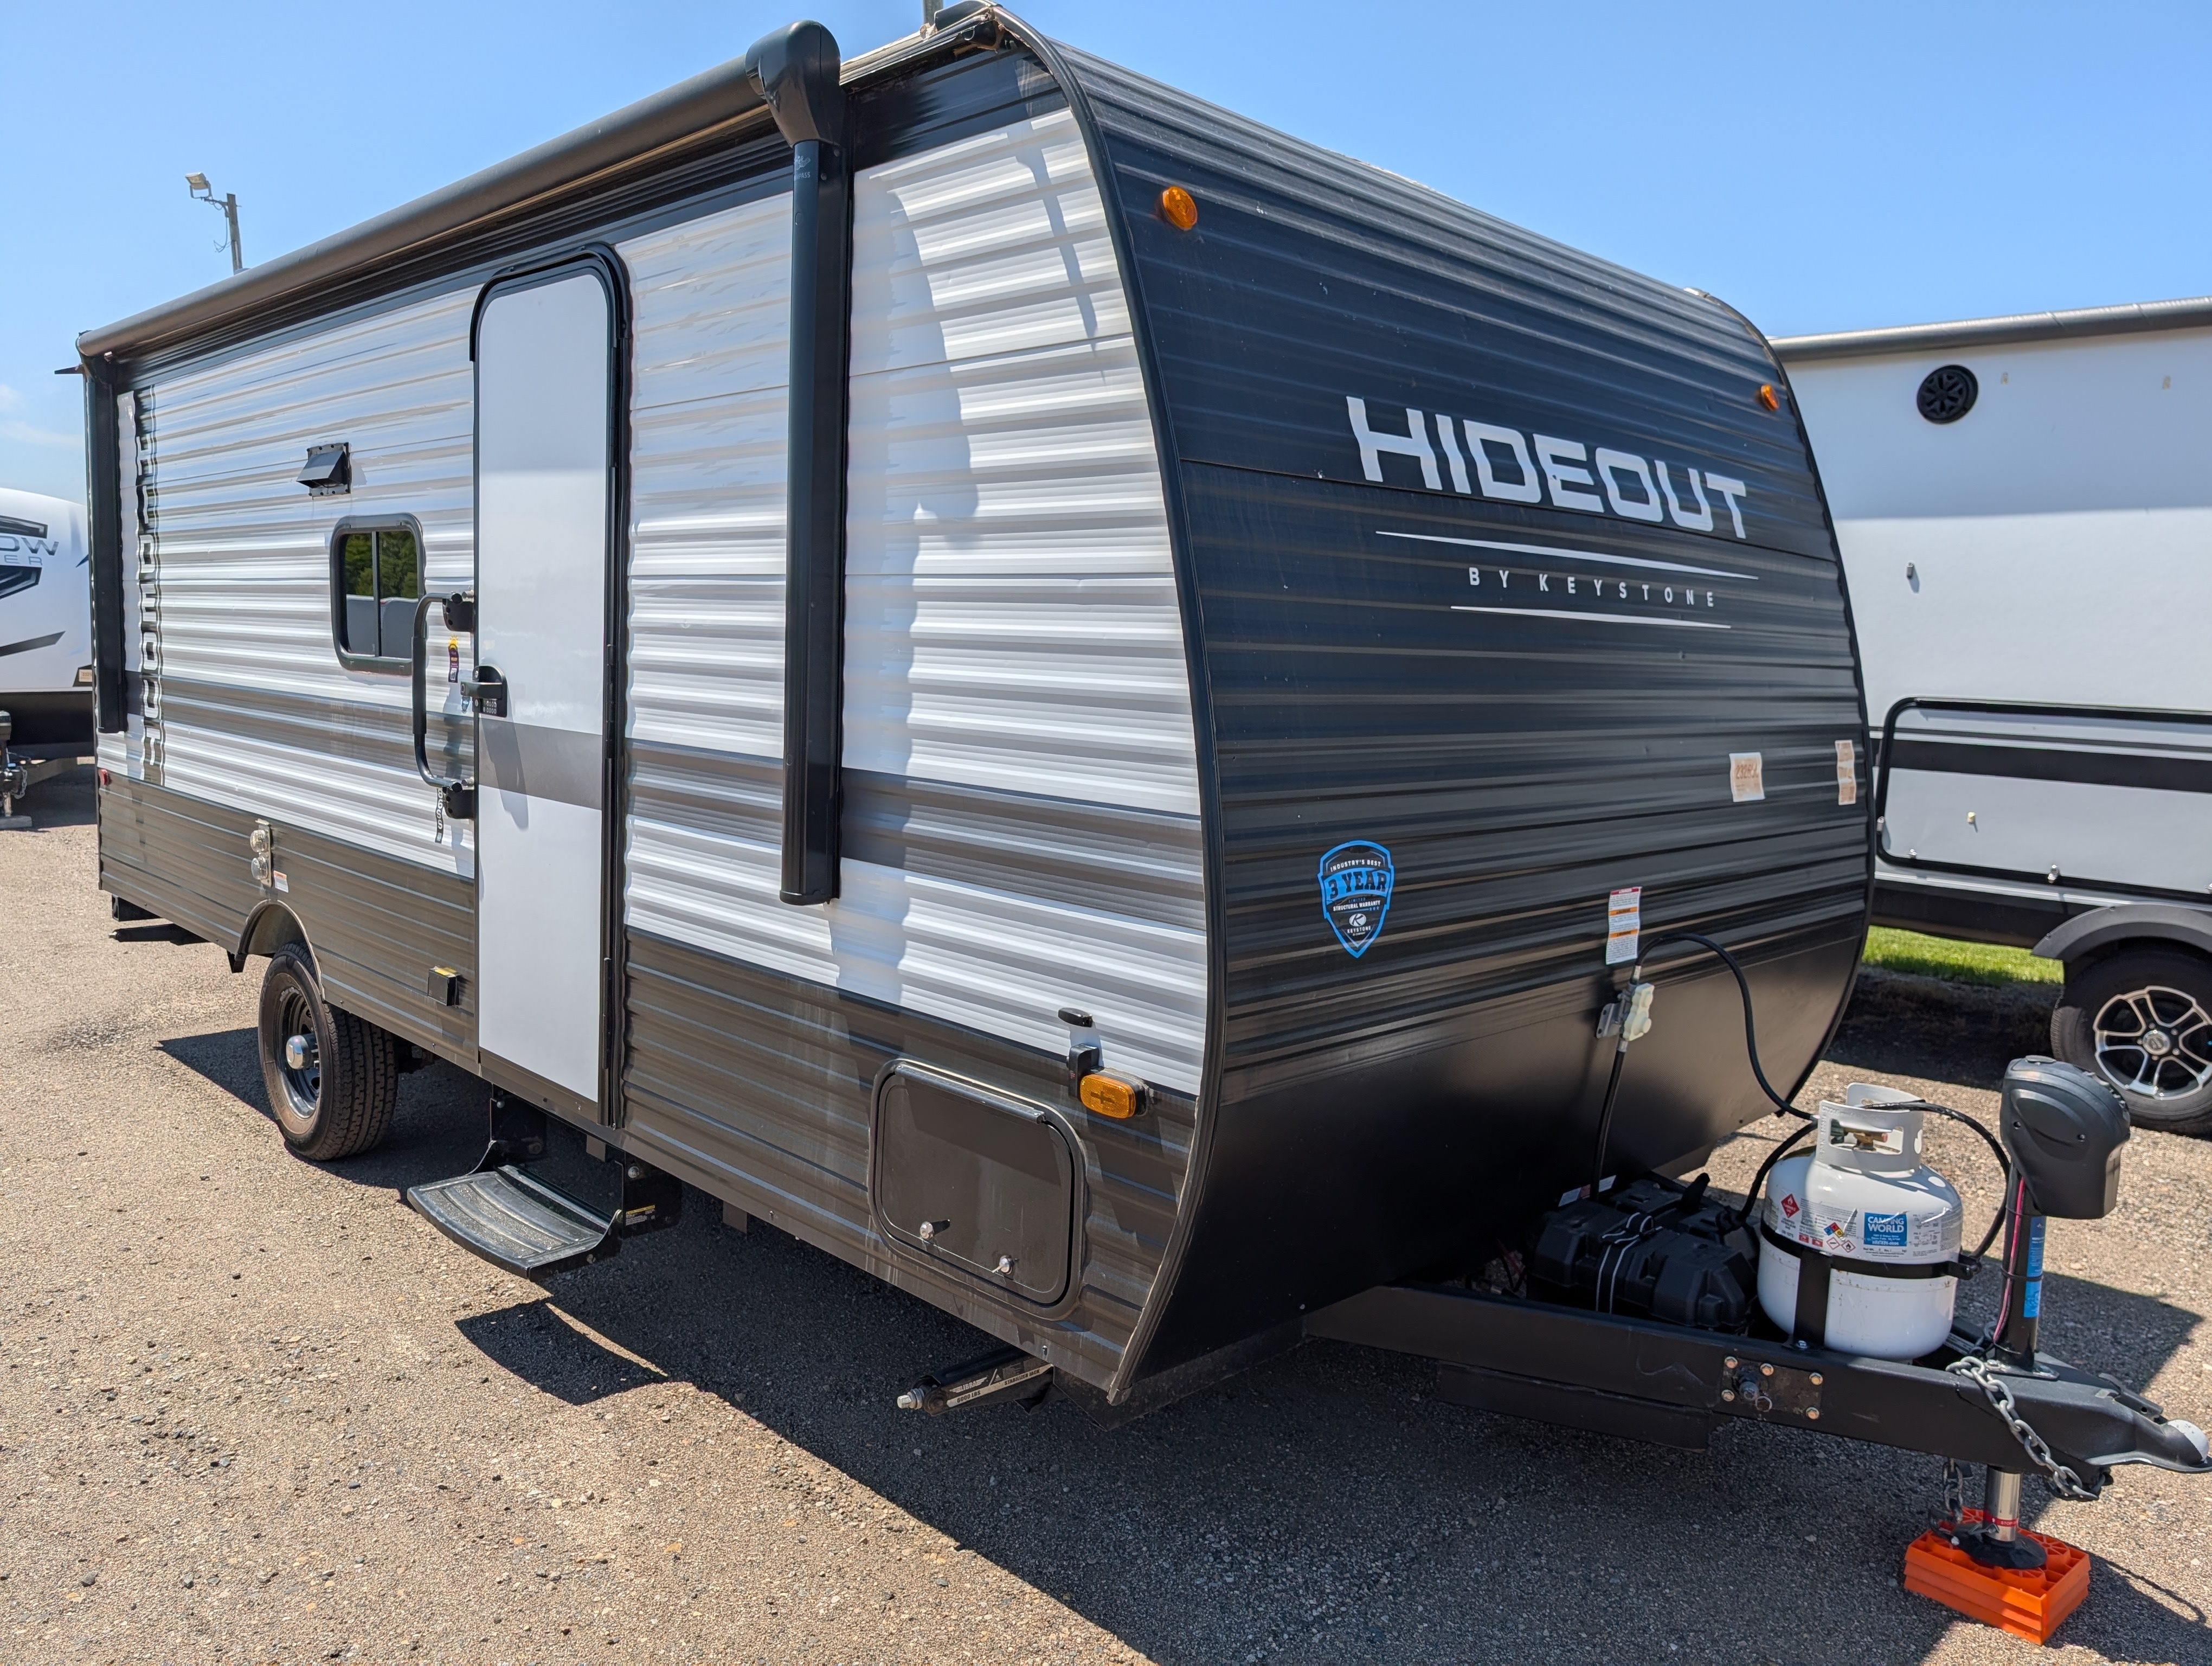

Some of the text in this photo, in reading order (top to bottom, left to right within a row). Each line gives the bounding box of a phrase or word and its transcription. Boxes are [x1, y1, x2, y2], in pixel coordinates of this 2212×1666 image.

[1346, 395, 1747, 539] HIDEOUT
[1469, 567, 1715, 607] BY KEYSTONE
[136, 433, 161, 766] HIDEOUT
[1330, 859, 1365, 873] INDUSTRY'S
[1328, 870, 1387, 900] 3 YEAR
[1333, 900, 1380, 911] STRUCTURAL WARRANTY
[1347, 925, 1371, 933] KEYSTONE
[1868, 1223, 1904, 1233] WORLD
[1029, 1369, 1040, 1377] JACK
[972, 1391, 981, 1399] LBS
